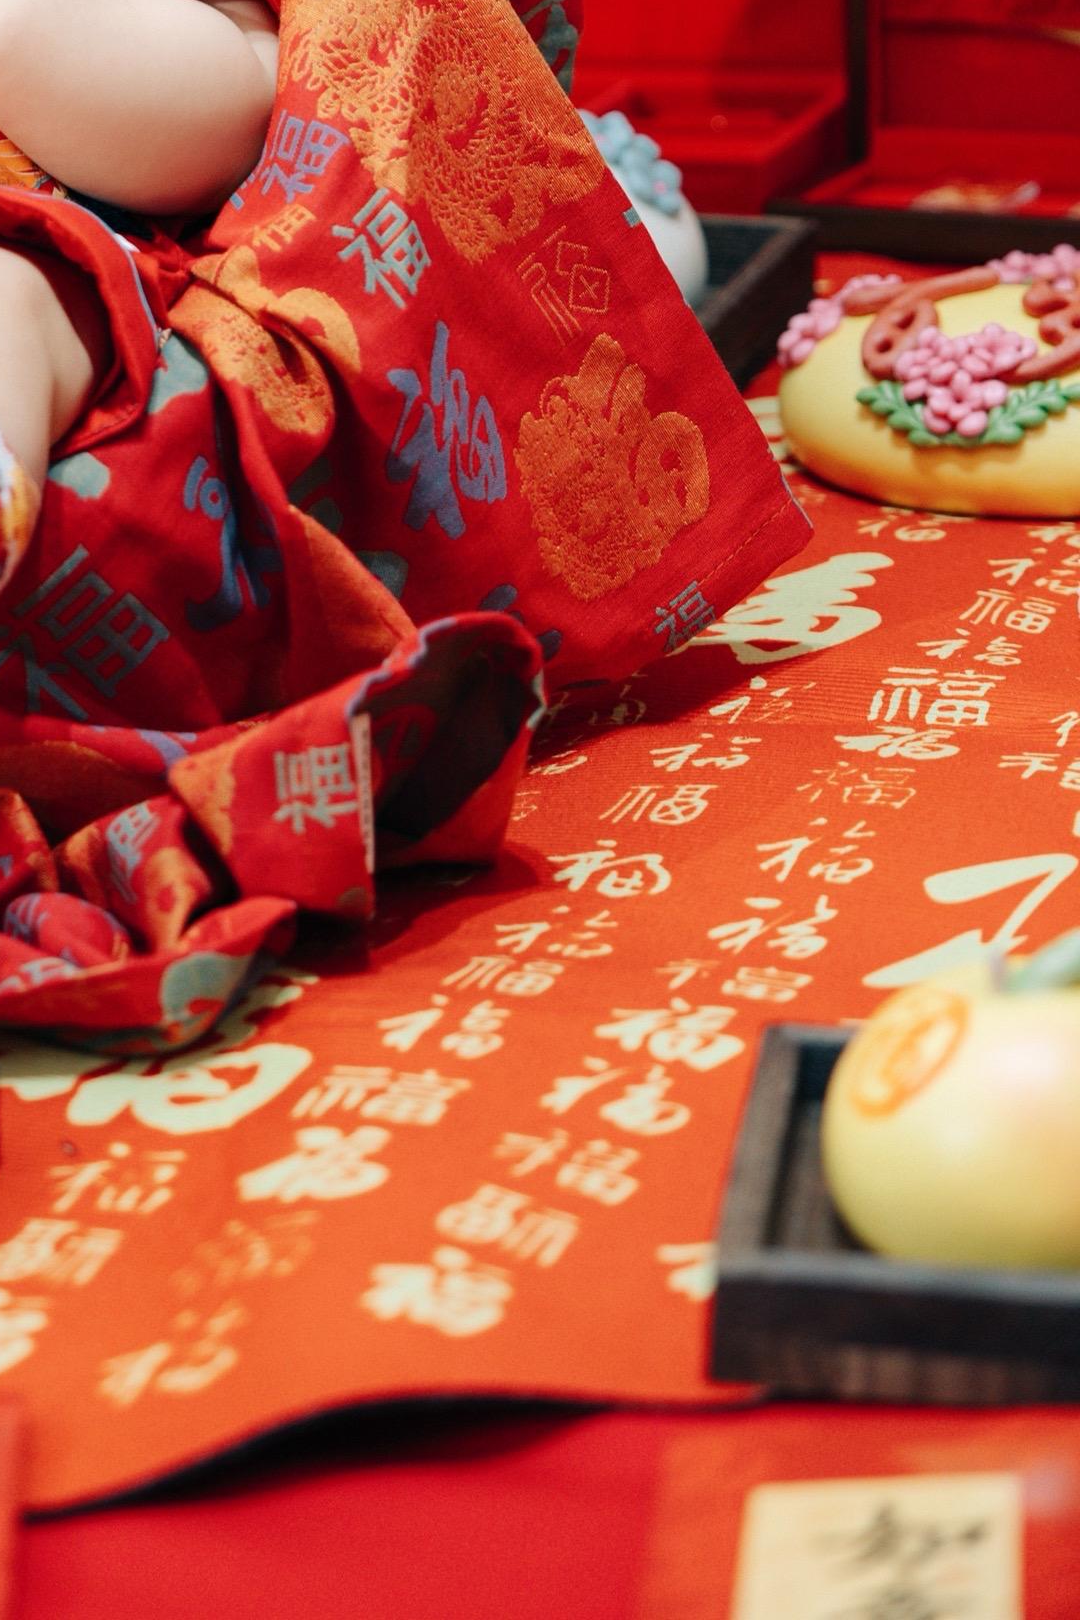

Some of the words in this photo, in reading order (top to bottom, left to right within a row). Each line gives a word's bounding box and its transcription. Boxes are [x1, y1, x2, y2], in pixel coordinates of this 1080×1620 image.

[258, 109, 352, 204] 福
[331, 187, 432, 309] 福
[654, 580, 718, 655] 福
[959, 589, 1062, 634] 福
[867, 667, 1006, 726] 福
[272, 742, 358, 835] 福
[598, 784, 719, 825] 福
